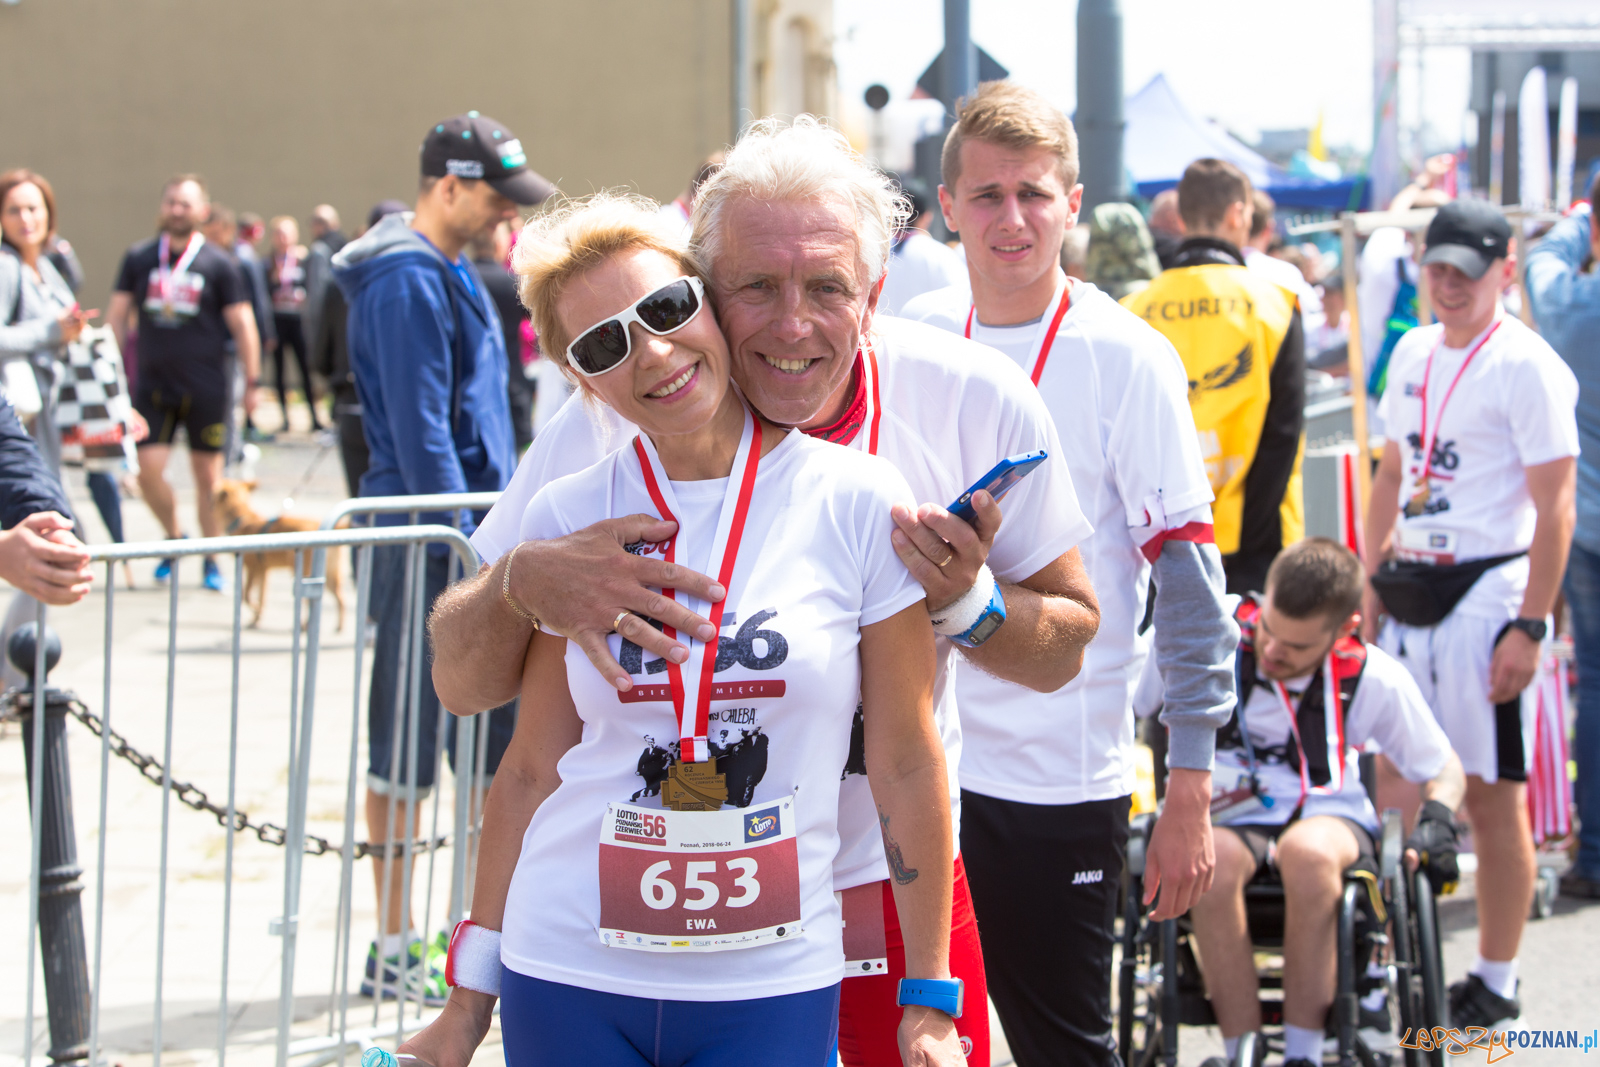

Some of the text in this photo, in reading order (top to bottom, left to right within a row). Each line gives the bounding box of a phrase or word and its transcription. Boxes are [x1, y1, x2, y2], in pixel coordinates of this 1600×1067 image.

[638, 685, 764, 697] BIE MIĘCI
[616, 808, 638, 821] LOTTO
[615, 825, 643, 836] CZERWIEC
[754, 818, 772, 833] LOTTO
[1072, 869, 1104, 884] JAKO
[640, 857, 761, 911] 653
[686, 918, 717, 930] EWA
